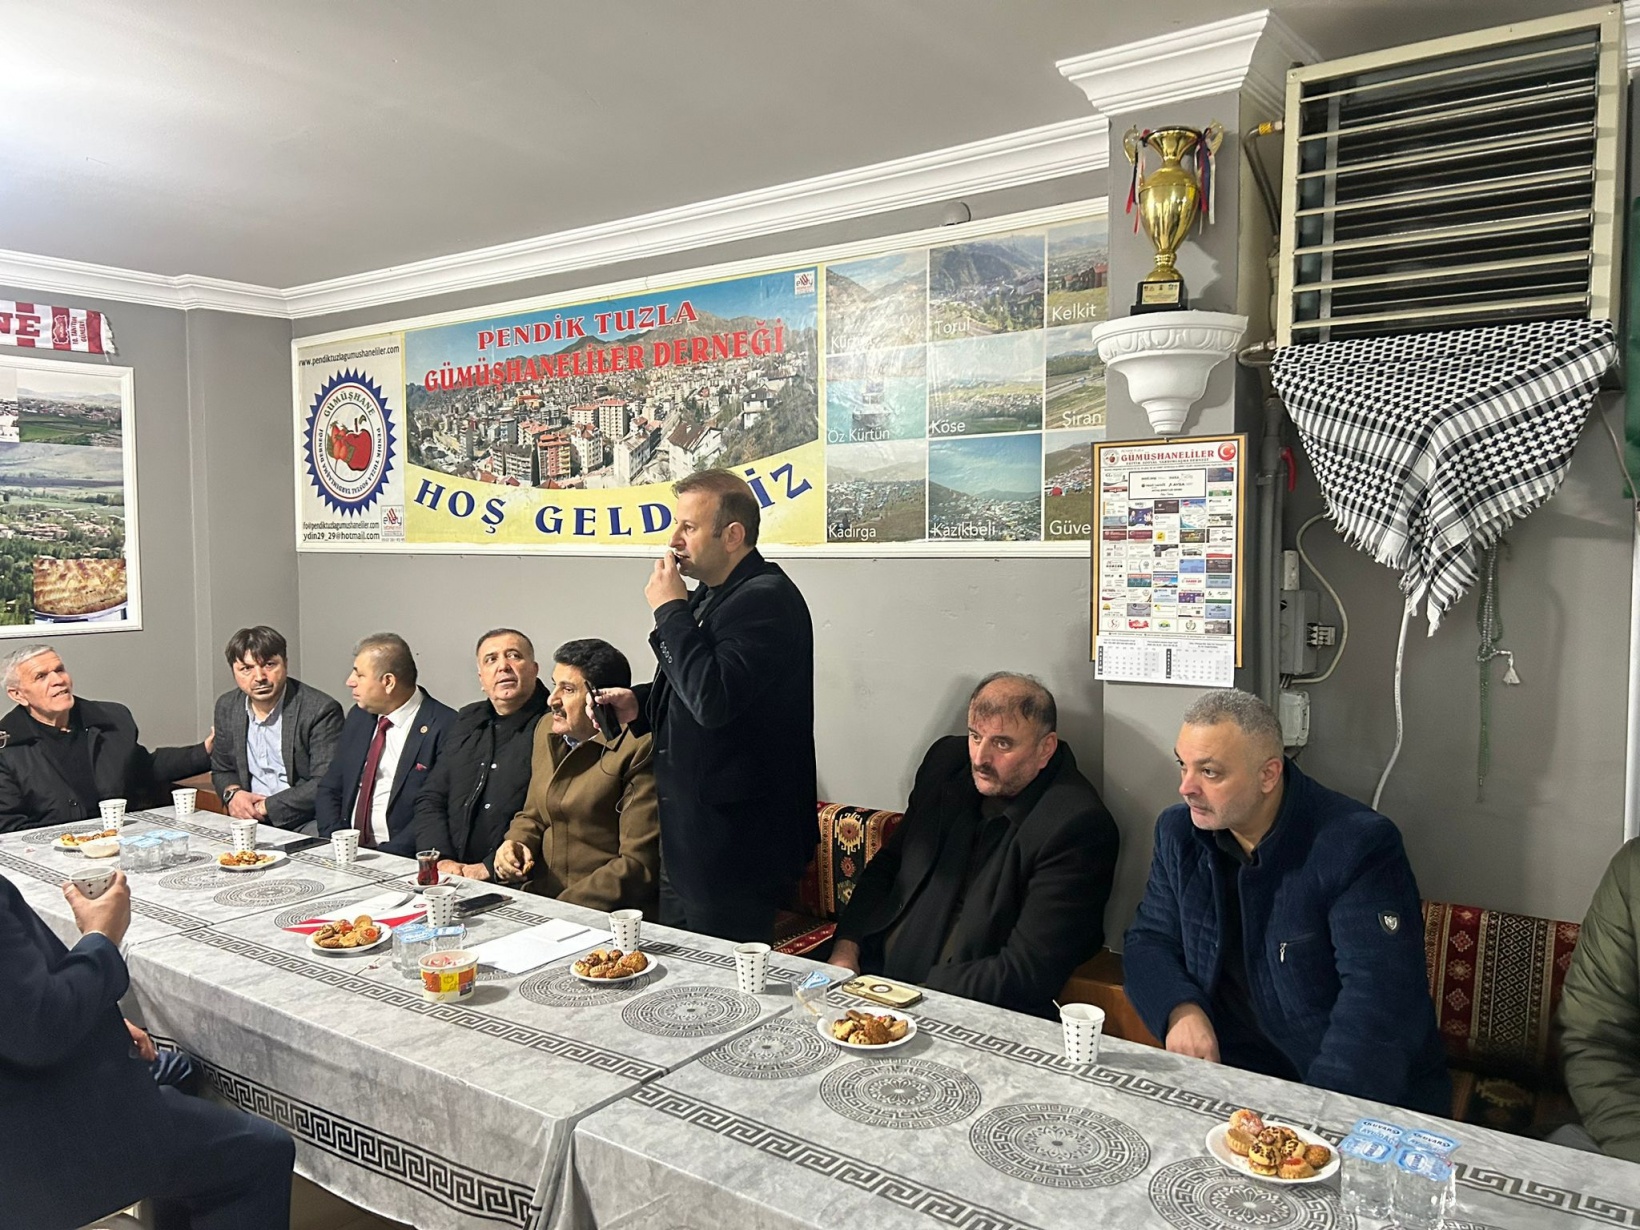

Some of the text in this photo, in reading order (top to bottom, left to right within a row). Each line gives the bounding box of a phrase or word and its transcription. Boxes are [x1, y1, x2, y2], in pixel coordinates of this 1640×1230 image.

[1052, 303, 1097, 321] Kelkit
[478, 300, 698, 352] PENDİK TUZLA
[934, 320, 971, 334] Torul
[424, 317, 785, 393] GÜMÜŞHANELİLER DERNEĞİ
[931, 419, 966, 434] Köse
[1062, 411, 1102, 428] Şiran
[828, 427, 890, 443] Öz Kürtün
[413, 462, 812, 537] HOŞ GELDİZ
[1049, 520, 1091, 535] Güve
